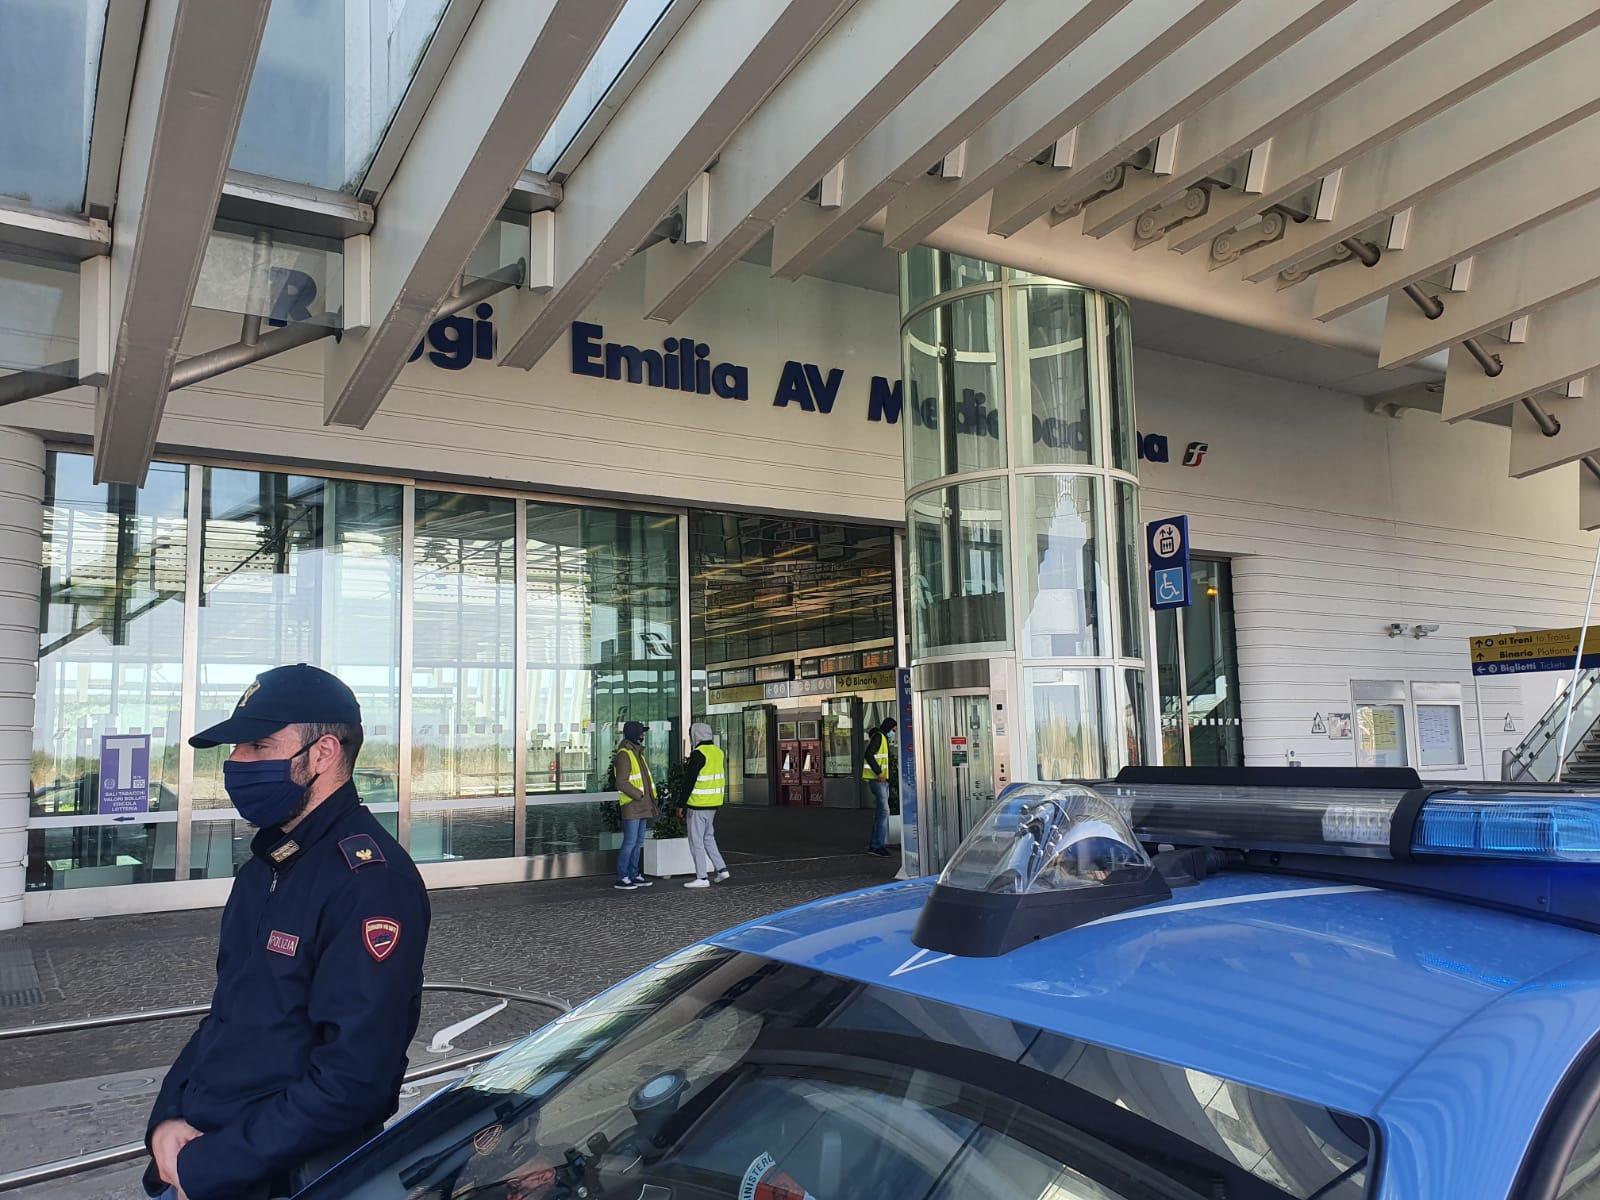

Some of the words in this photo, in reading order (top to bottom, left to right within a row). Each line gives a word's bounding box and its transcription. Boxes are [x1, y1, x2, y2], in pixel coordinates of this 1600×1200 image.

[571, 321, 749, 401] Emilia
[773, 360, 844, 414] AV
[1499, 649, 1534, 659] Binario
[1537, 647, 1570, 656] Platform
[1500, 661, 1537, 673] Biglietti
[853, 675, 878, 686] Binario
[106, 738, 146, 790] T
[270, 935, 295, 951] POLIZIA
[743, 1154, 774, 1200] INISTER
